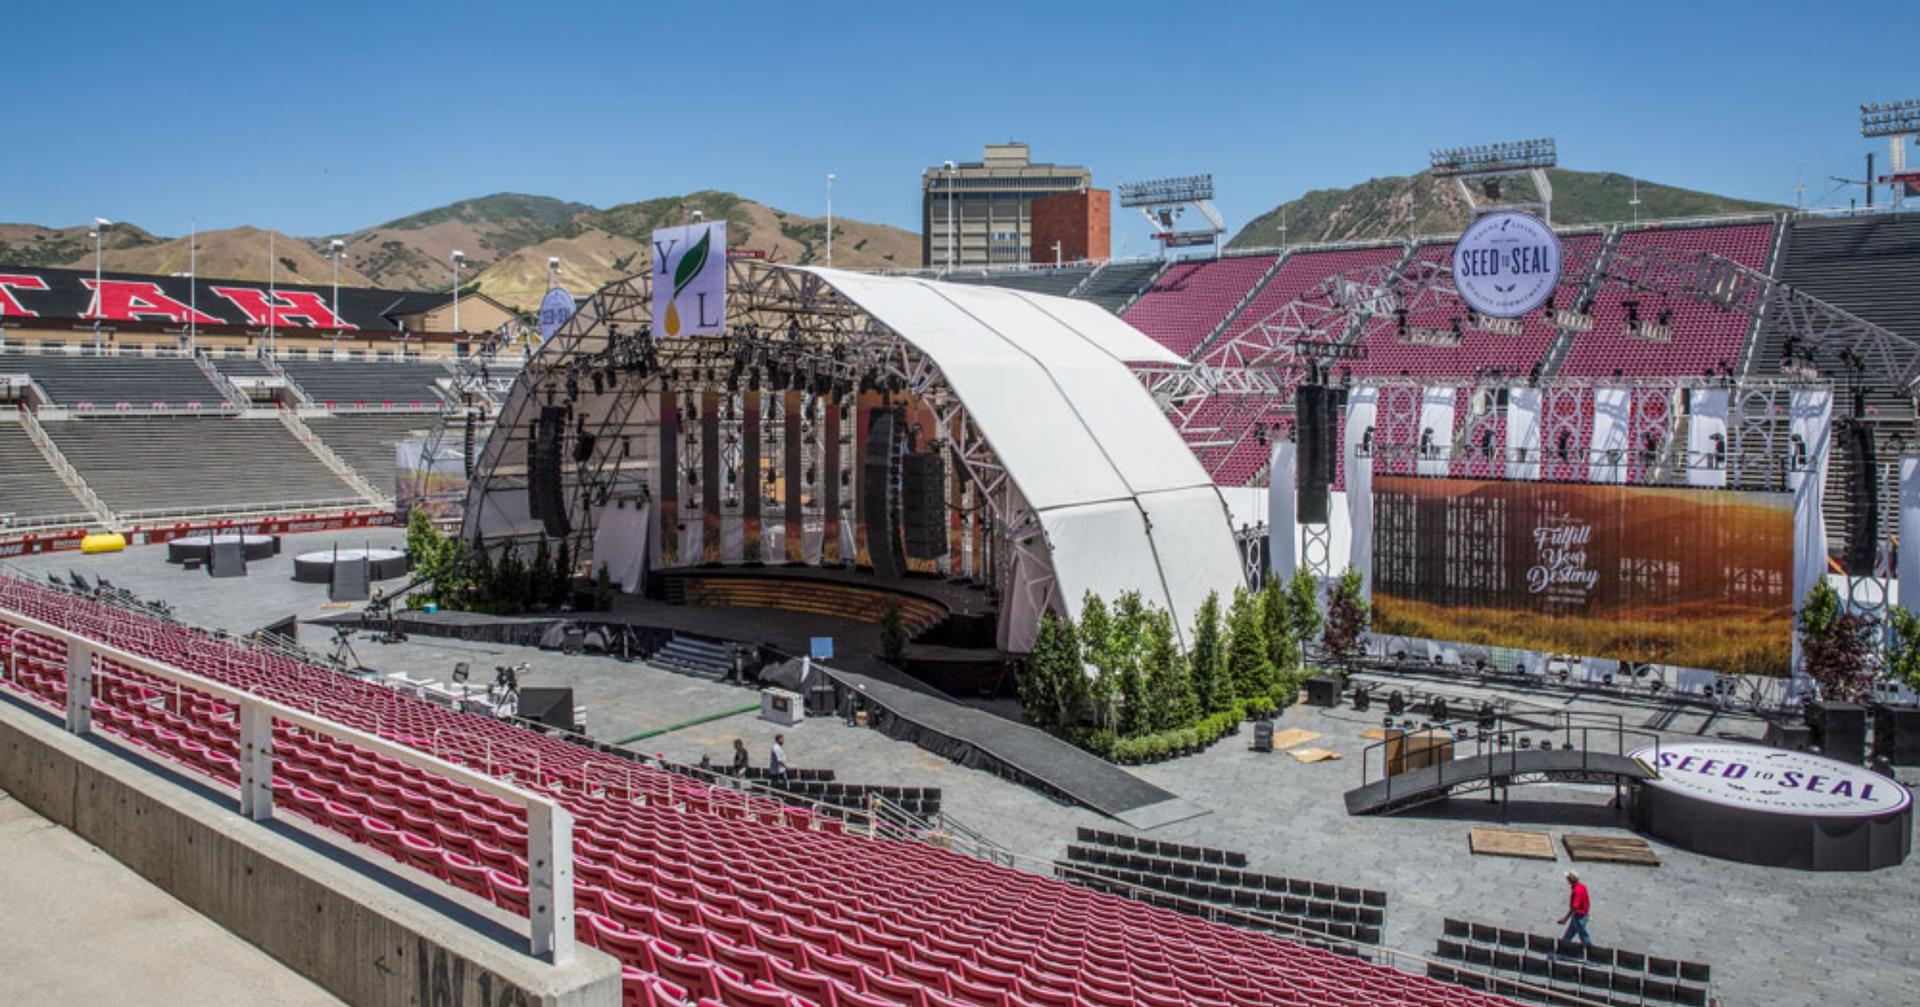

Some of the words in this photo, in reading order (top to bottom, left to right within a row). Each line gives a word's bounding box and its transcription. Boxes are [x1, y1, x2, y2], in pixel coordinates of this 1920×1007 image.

[654, 239, 678, 275] Y
[1461, 249, 1499, 277] SEED
[1501, 254, 1511, 268] TO
[1511, 246, 1550, 275] SEAL
[697, 292, 719, 328] L
[1533, 525, 1591, 550] Fulfill
[1542, 548, 1587, 570] Your
[1526, 565, 1599, 593] Destiny
[1652, 751, 1749, 780] SEED
[1754, 770, 1774, 780] TO
[1778, 771, 1879, 803] SEAL
